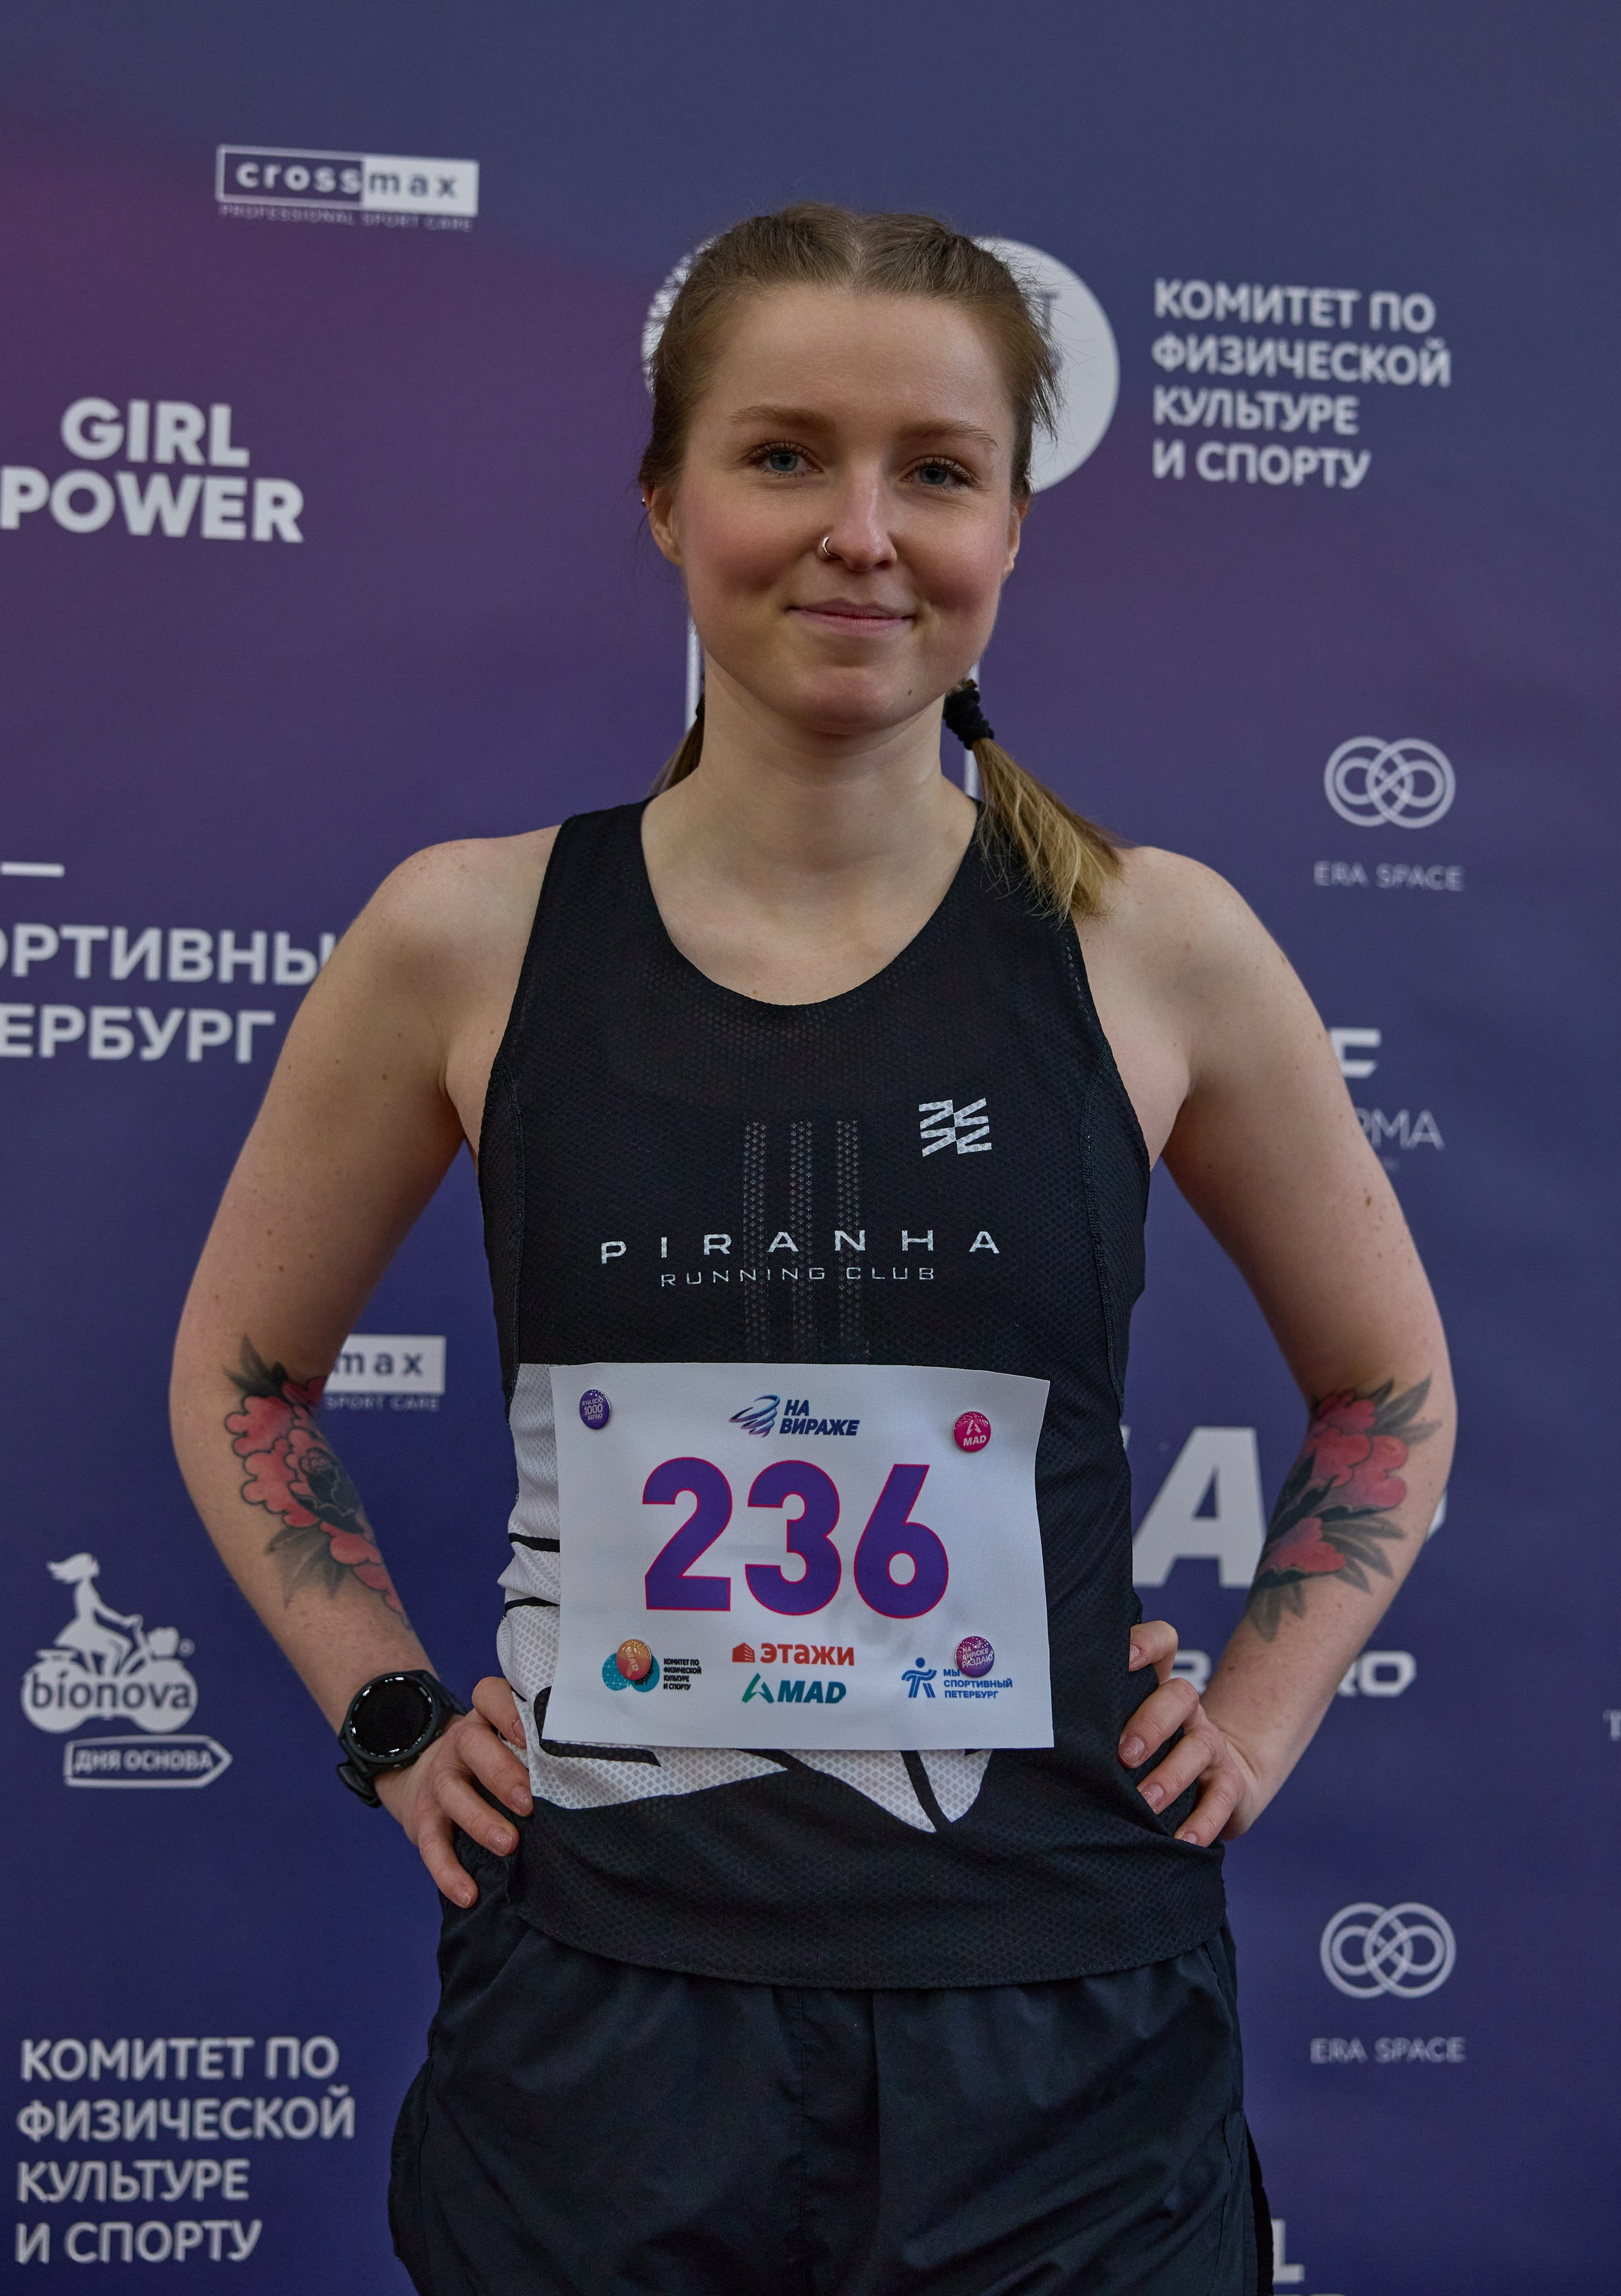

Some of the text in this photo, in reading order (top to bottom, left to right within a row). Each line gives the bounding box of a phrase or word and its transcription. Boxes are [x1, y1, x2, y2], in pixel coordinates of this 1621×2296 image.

[236, 162, 457, 198] crossmax
[360, 211, 419, 229] SPORT
[1153, 278, 1436, 333] КОМИТЕТ ПО
[1152, 333, 1451, 387] ФИЗИЧЕСКОЙ
[1153, 386, 1359, 435] КУЛЬТУРЕ
[61, 397, 249, 467] GIRL
[1152, 438, 1371, 490] И СПОРТУ
[0, 465, 304, 543] POWER
[1313, 860, 1465, 891] ERA SPACE
[0, 923, 337, 986] РТИВНЫ
[601, 1229, 1000, 1264] PIRANHA
[661, 1267, 936, 1286] RUNNING CLUB
[325, 1394, 439, 1412] SPORT CARE
[584, 1403, 603, 1416] 1000
[784, 1400, 809, 1416] НА
[779, 1418, 860, 1436] ВИРАЖЕ
[963, 1435, 987, 1447] MAD
[642, 1456, 949, 1619] 236
[663, 1666, 702, 1674] ФИЗИЧЕСКОЙ
[943, 1668, 960, 1677] МЫ
[943, 1678, 1012, 1688] СПОРТИВНЫЙ
[32, 1670, 191, 1709] bionova
[777, 1680, 847, 1703] MAD
[944, 1690, 999, 1699] ПЕТЕРБУРГ
[74, 1749, 214, 1773] ДНЯ ОСНОВА
[20, 2036, 340, 2081] КОМИТЕТ ПО
[1310, 2036, 1466, 2064] ERA SPACE
[16, 2084, 356, 2143] ФИЗИЧЕСКОЙ
[16, 2159, 251, 2203] КУЛЬТУРЕ
[15, 2219, 263, 2264] И СПОРТУ
